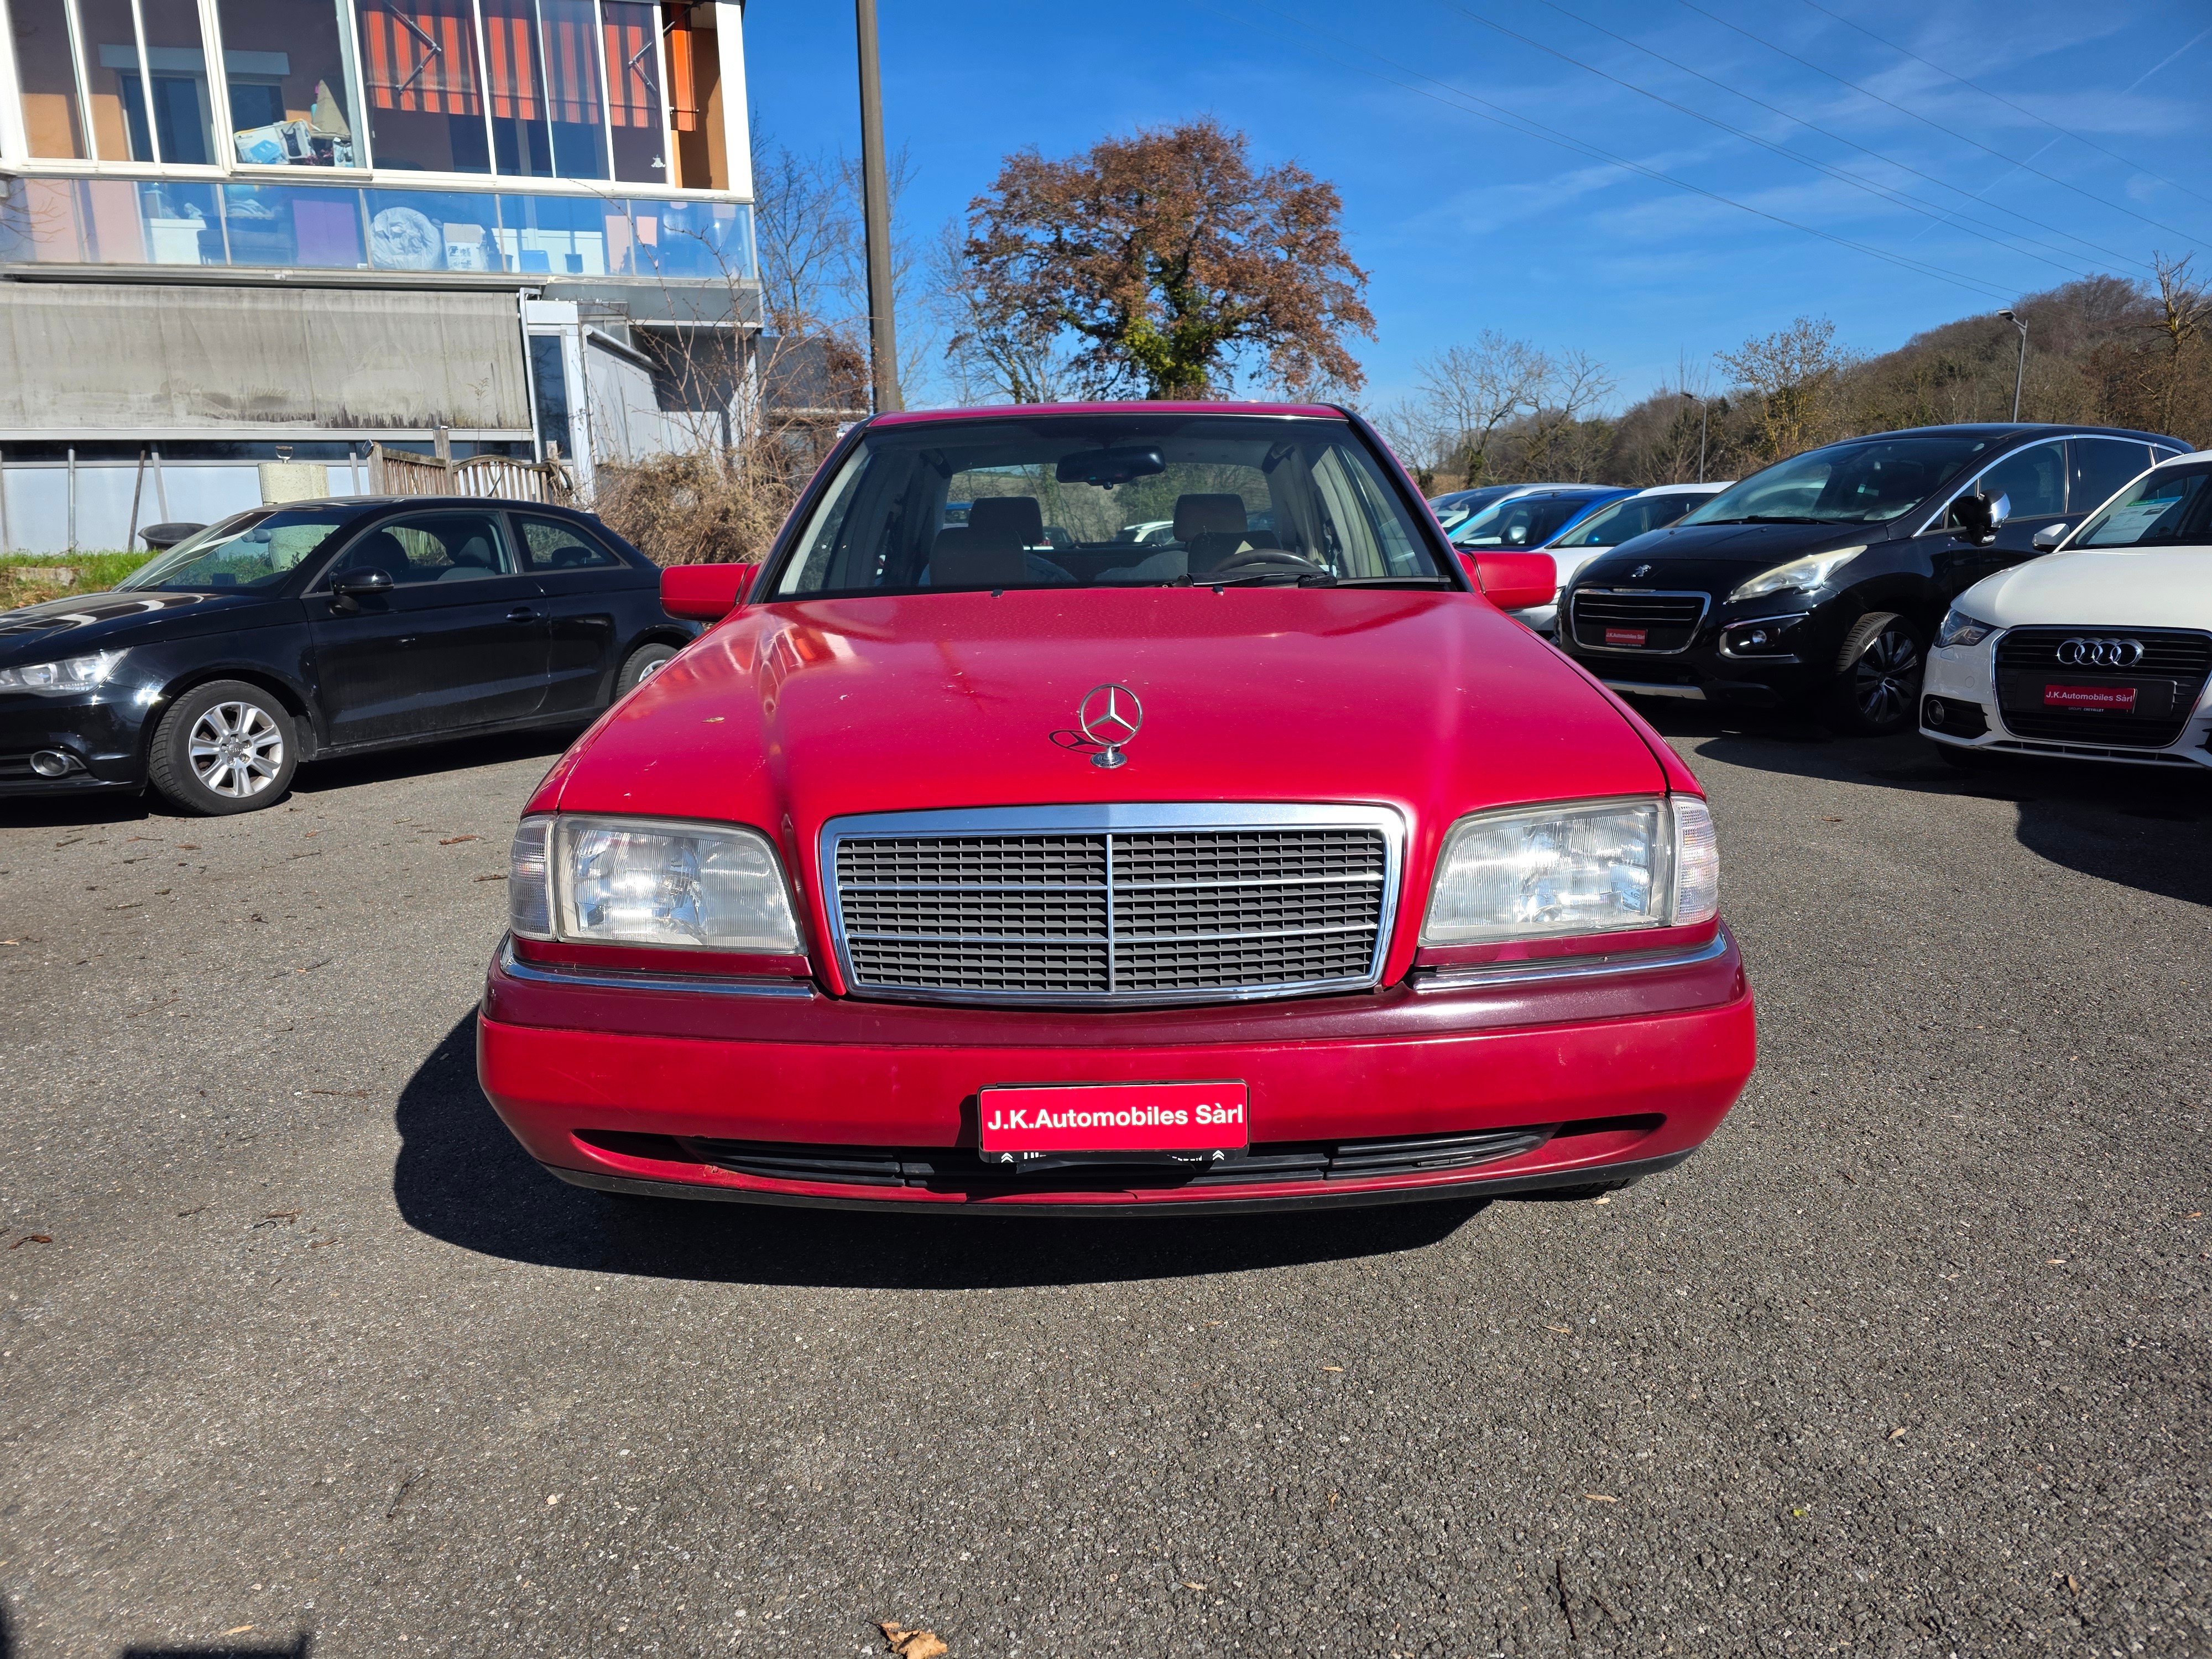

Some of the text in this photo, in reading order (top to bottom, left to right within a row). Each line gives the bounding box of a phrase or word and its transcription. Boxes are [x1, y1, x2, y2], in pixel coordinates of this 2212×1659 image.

[2046, 691, 2133, 702] J.K.Automobiles Sàrl
[988, 1103, 1243, 1130] J.K.Automobiles Sàrl
